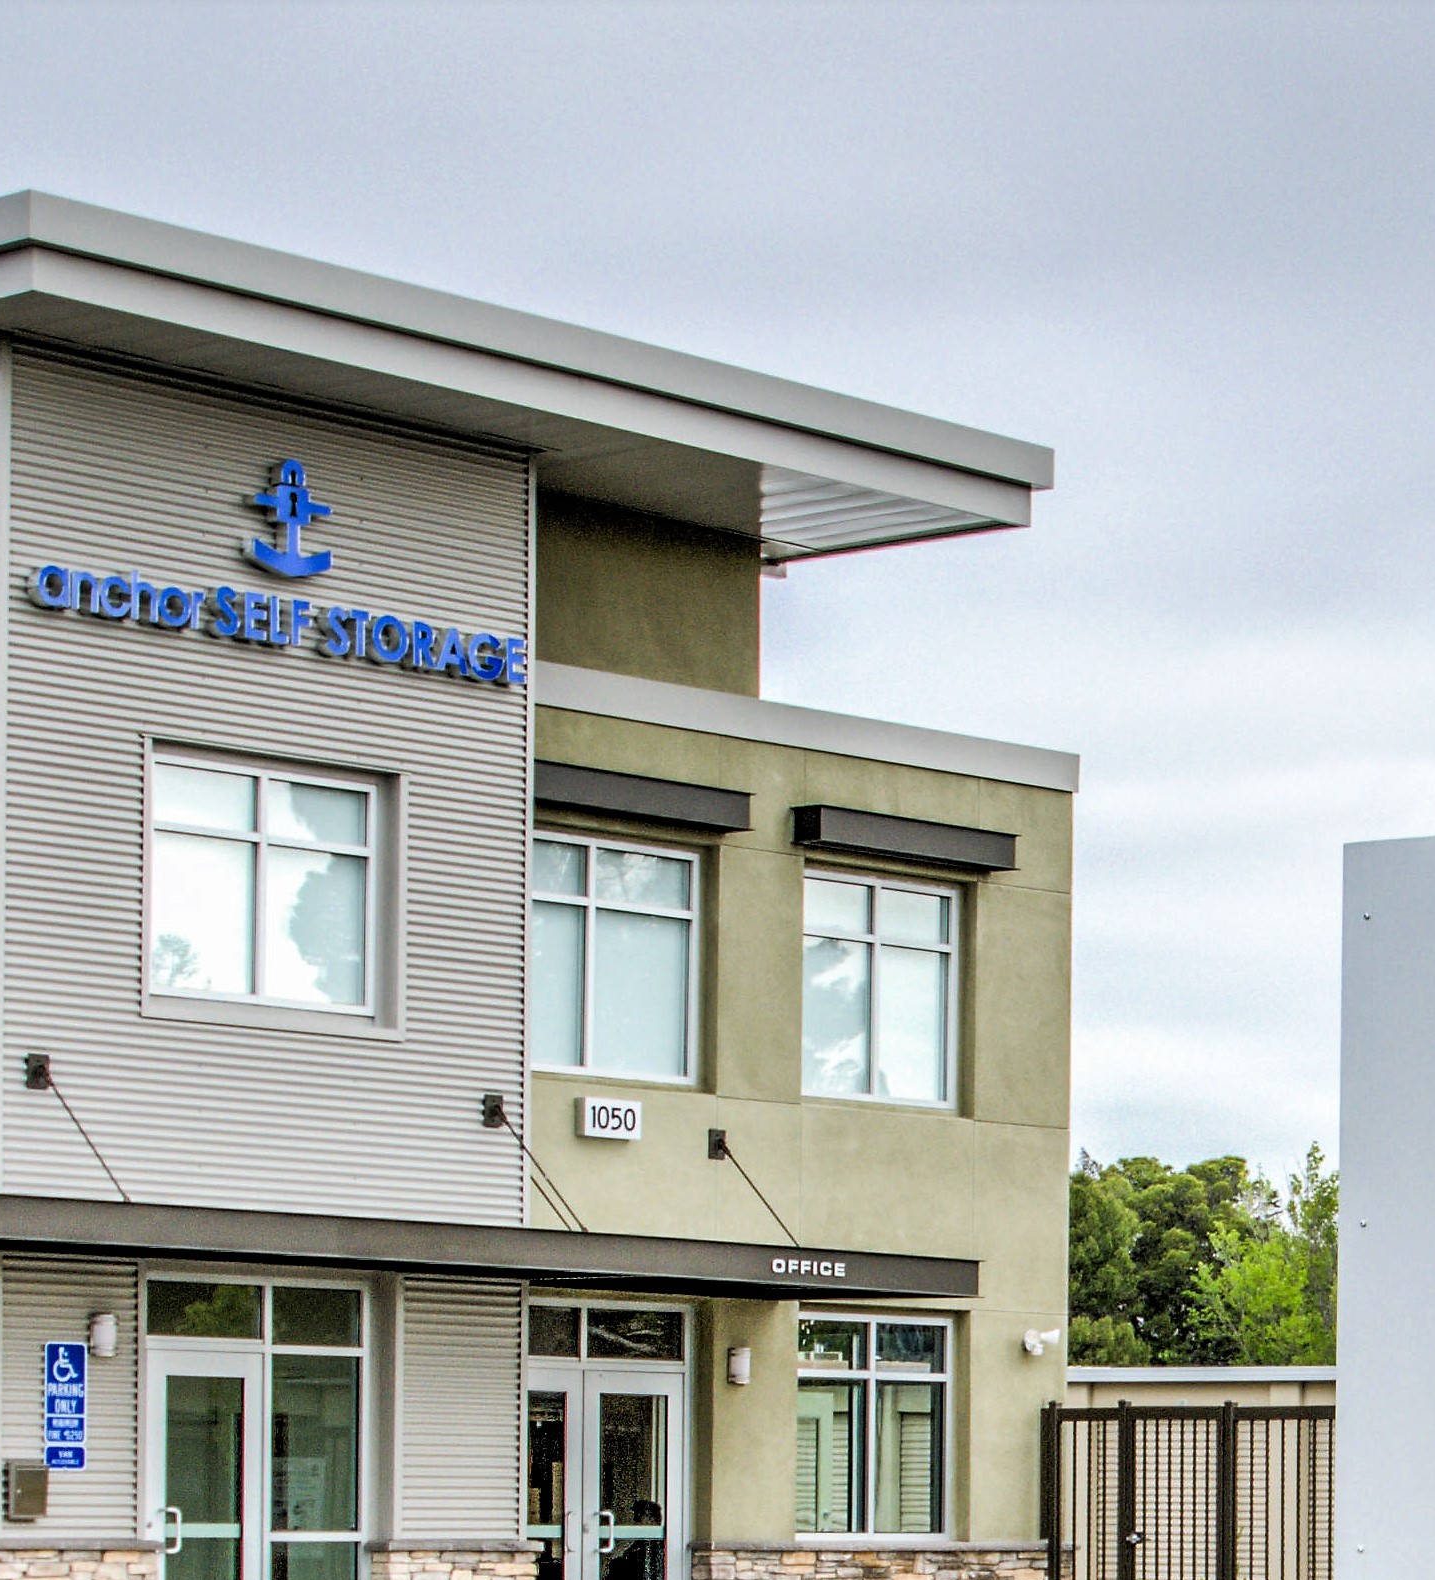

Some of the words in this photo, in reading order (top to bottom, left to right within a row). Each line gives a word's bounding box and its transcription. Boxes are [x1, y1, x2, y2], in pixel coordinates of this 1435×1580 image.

[35, 565, 204, 629] anchor
[213, 586, 313, 646] SELF
[325, 607, 528, 684] STORAGE
[591, 1105, 636, 1132] 1050
[771, 1258, 846, 1278] OFFICE
[47, 1383, 84, 1398] PARKING
[54, 1398, 77, 1413] ONLY
